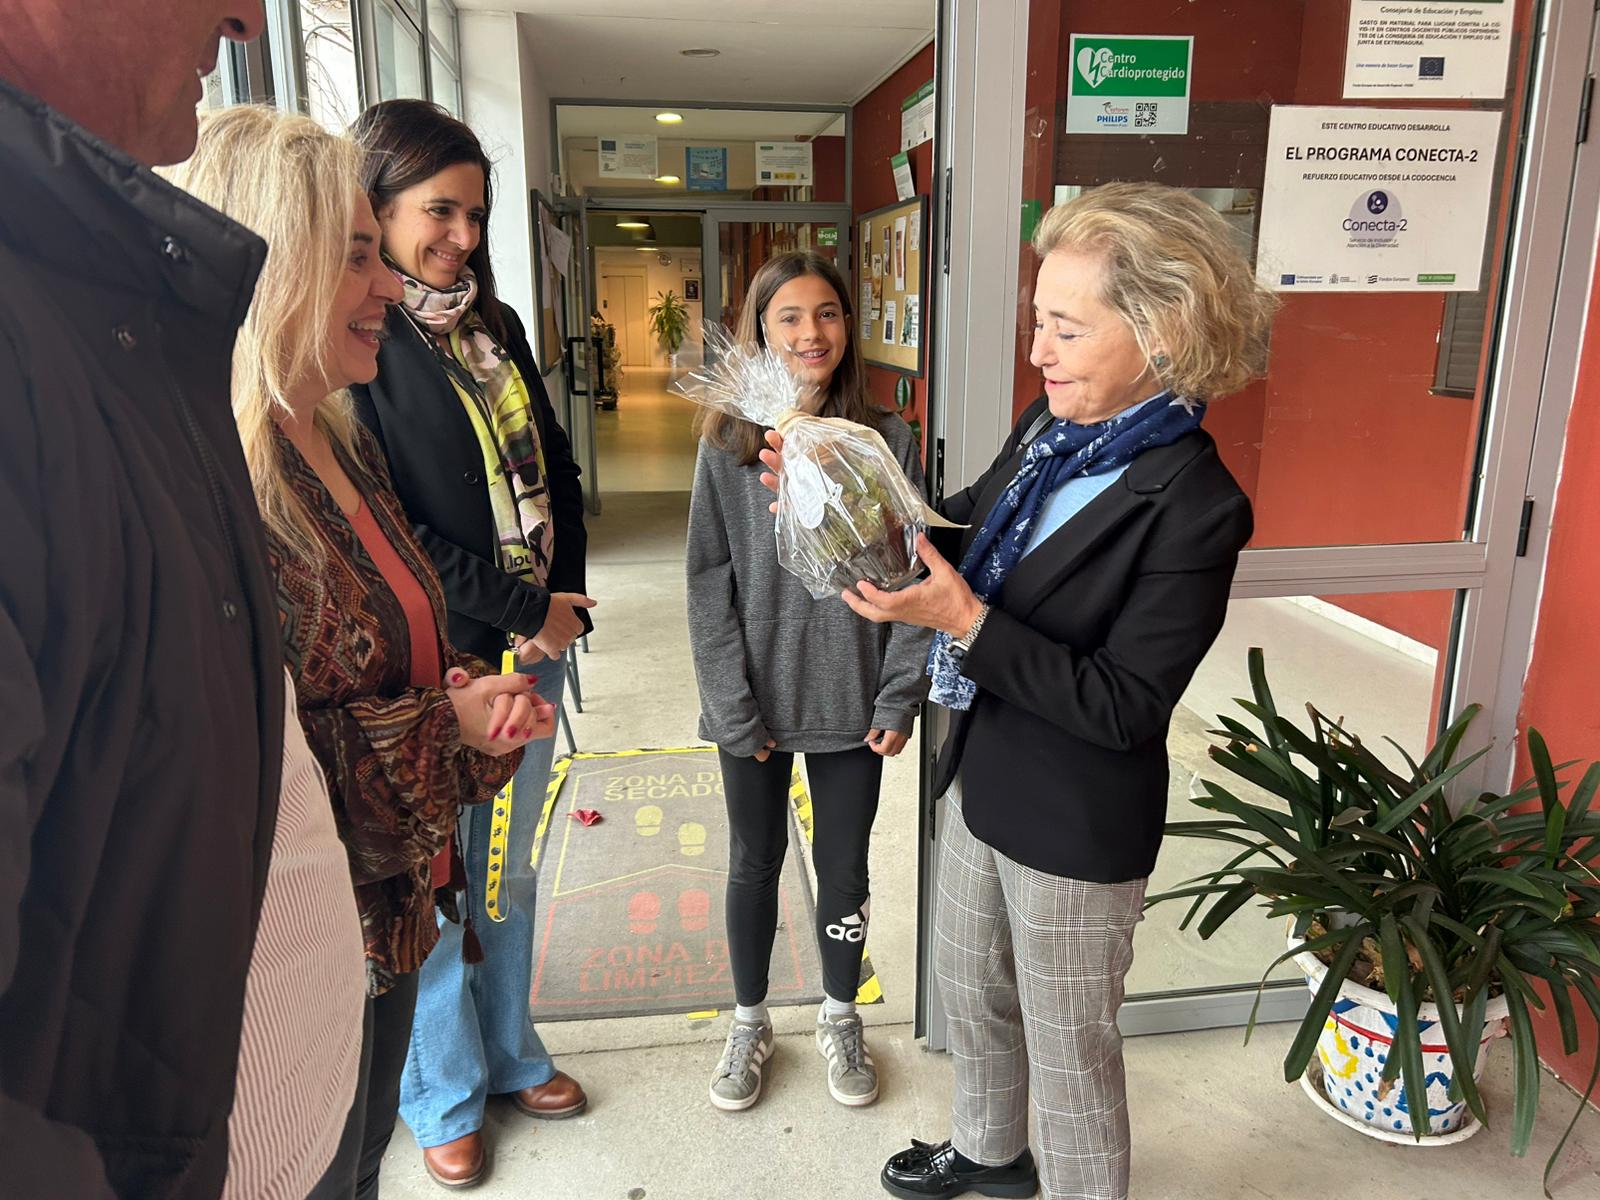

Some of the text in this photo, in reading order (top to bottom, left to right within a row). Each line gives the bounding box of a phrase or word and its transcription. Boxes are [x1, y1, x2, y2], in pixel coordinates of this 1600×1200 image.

[1380, 6, 1413, 15] Consejería
[1460, 8, 1483, 16] Empleo
[1100, 51, 1137, 64] Centro
[1100, 66, 1185, 81] Cardioprotegido
[1096, 115, 1129, 123] PHILIPS
[1321, 122, 1338, 130] ESTE
[1368, 123, 1407, 131] EDUCATIVO
[1407, 124, 1451, 132] DESARROLLA
[1285, 146, 1479, 163] EL PROGRAMA CONECTA-2
[1302, 173, 1338, 181] REFUERZO
[1339, 173, 1378, 181] EDUCATIVO
[1411, 174, 1457, 182] CODOCENCIA
[1342, 218, 1408, 231] Conecta-2
[606, 773, 688, 788] ZONA
[826, 921, 866, 942] ad
[582, 942, 690, 969] ZONA
